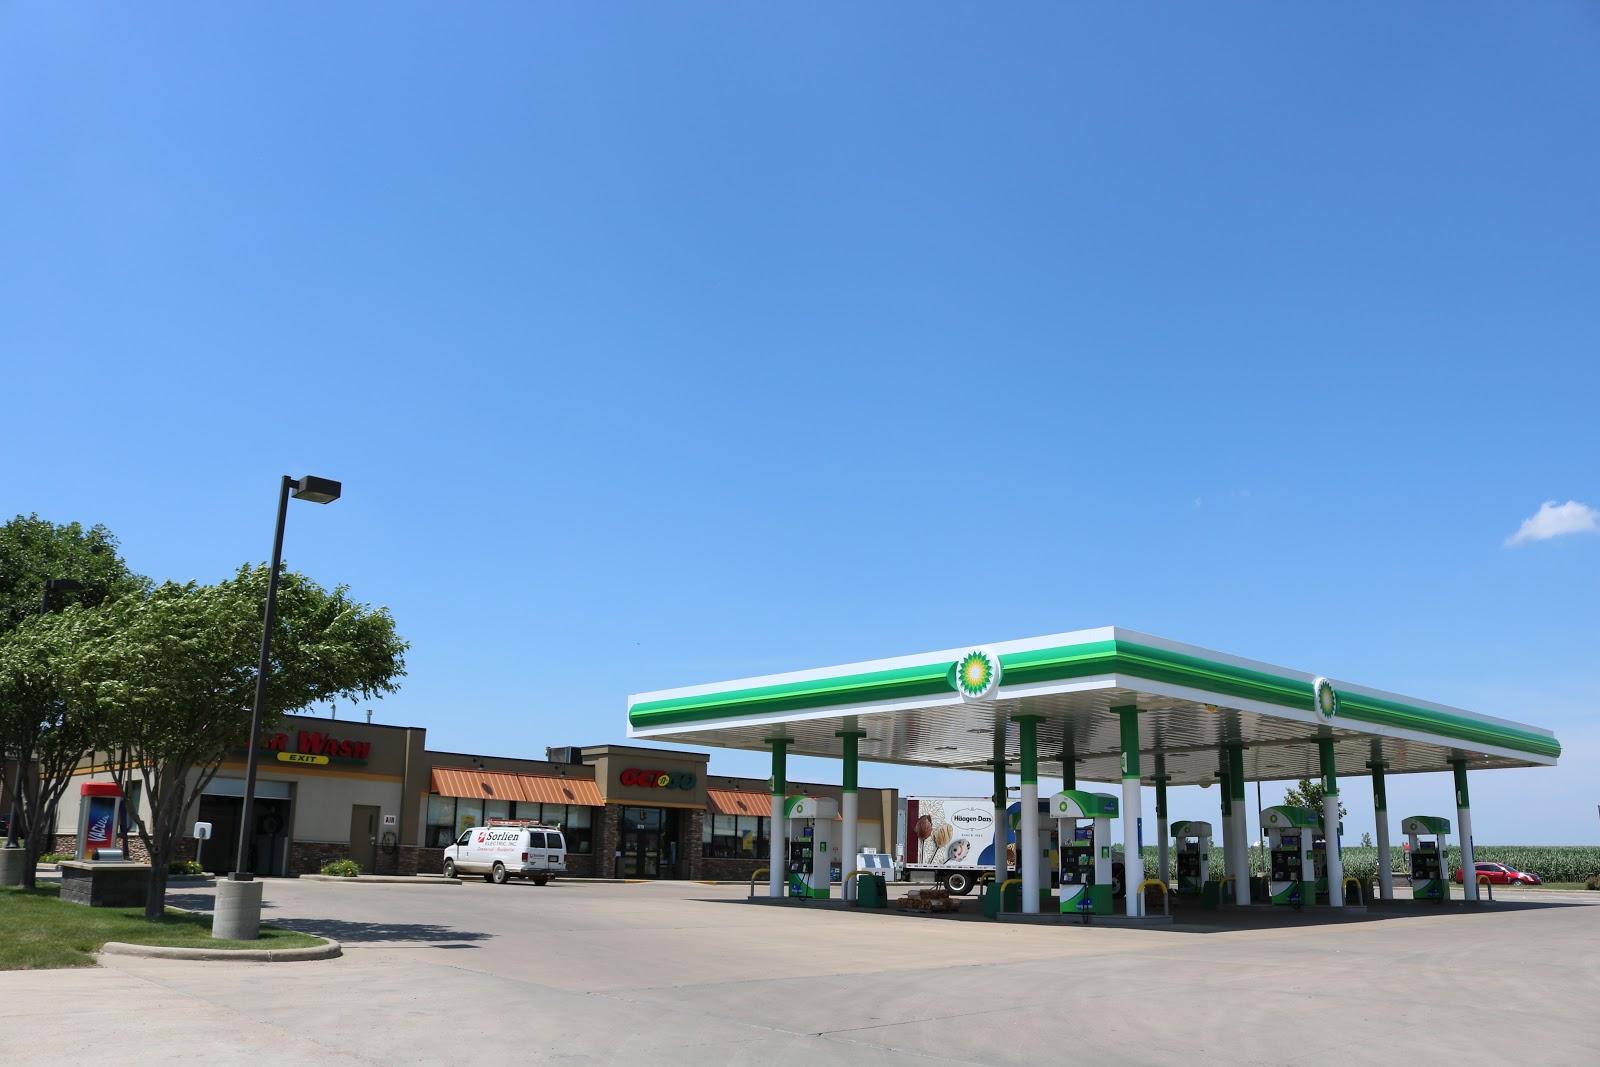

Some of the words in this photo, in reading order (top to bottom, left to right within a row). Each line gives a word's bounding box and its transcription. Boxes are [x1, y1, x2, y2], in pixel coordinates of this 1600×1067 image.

[297, 730, 372, 759] WASH
[289, 754, 317, 763] EXIT
[621, 767, 664, 788] GET
[385, 816, 395, 824] AIR
[486, 831, 520, 841] Sorlien
